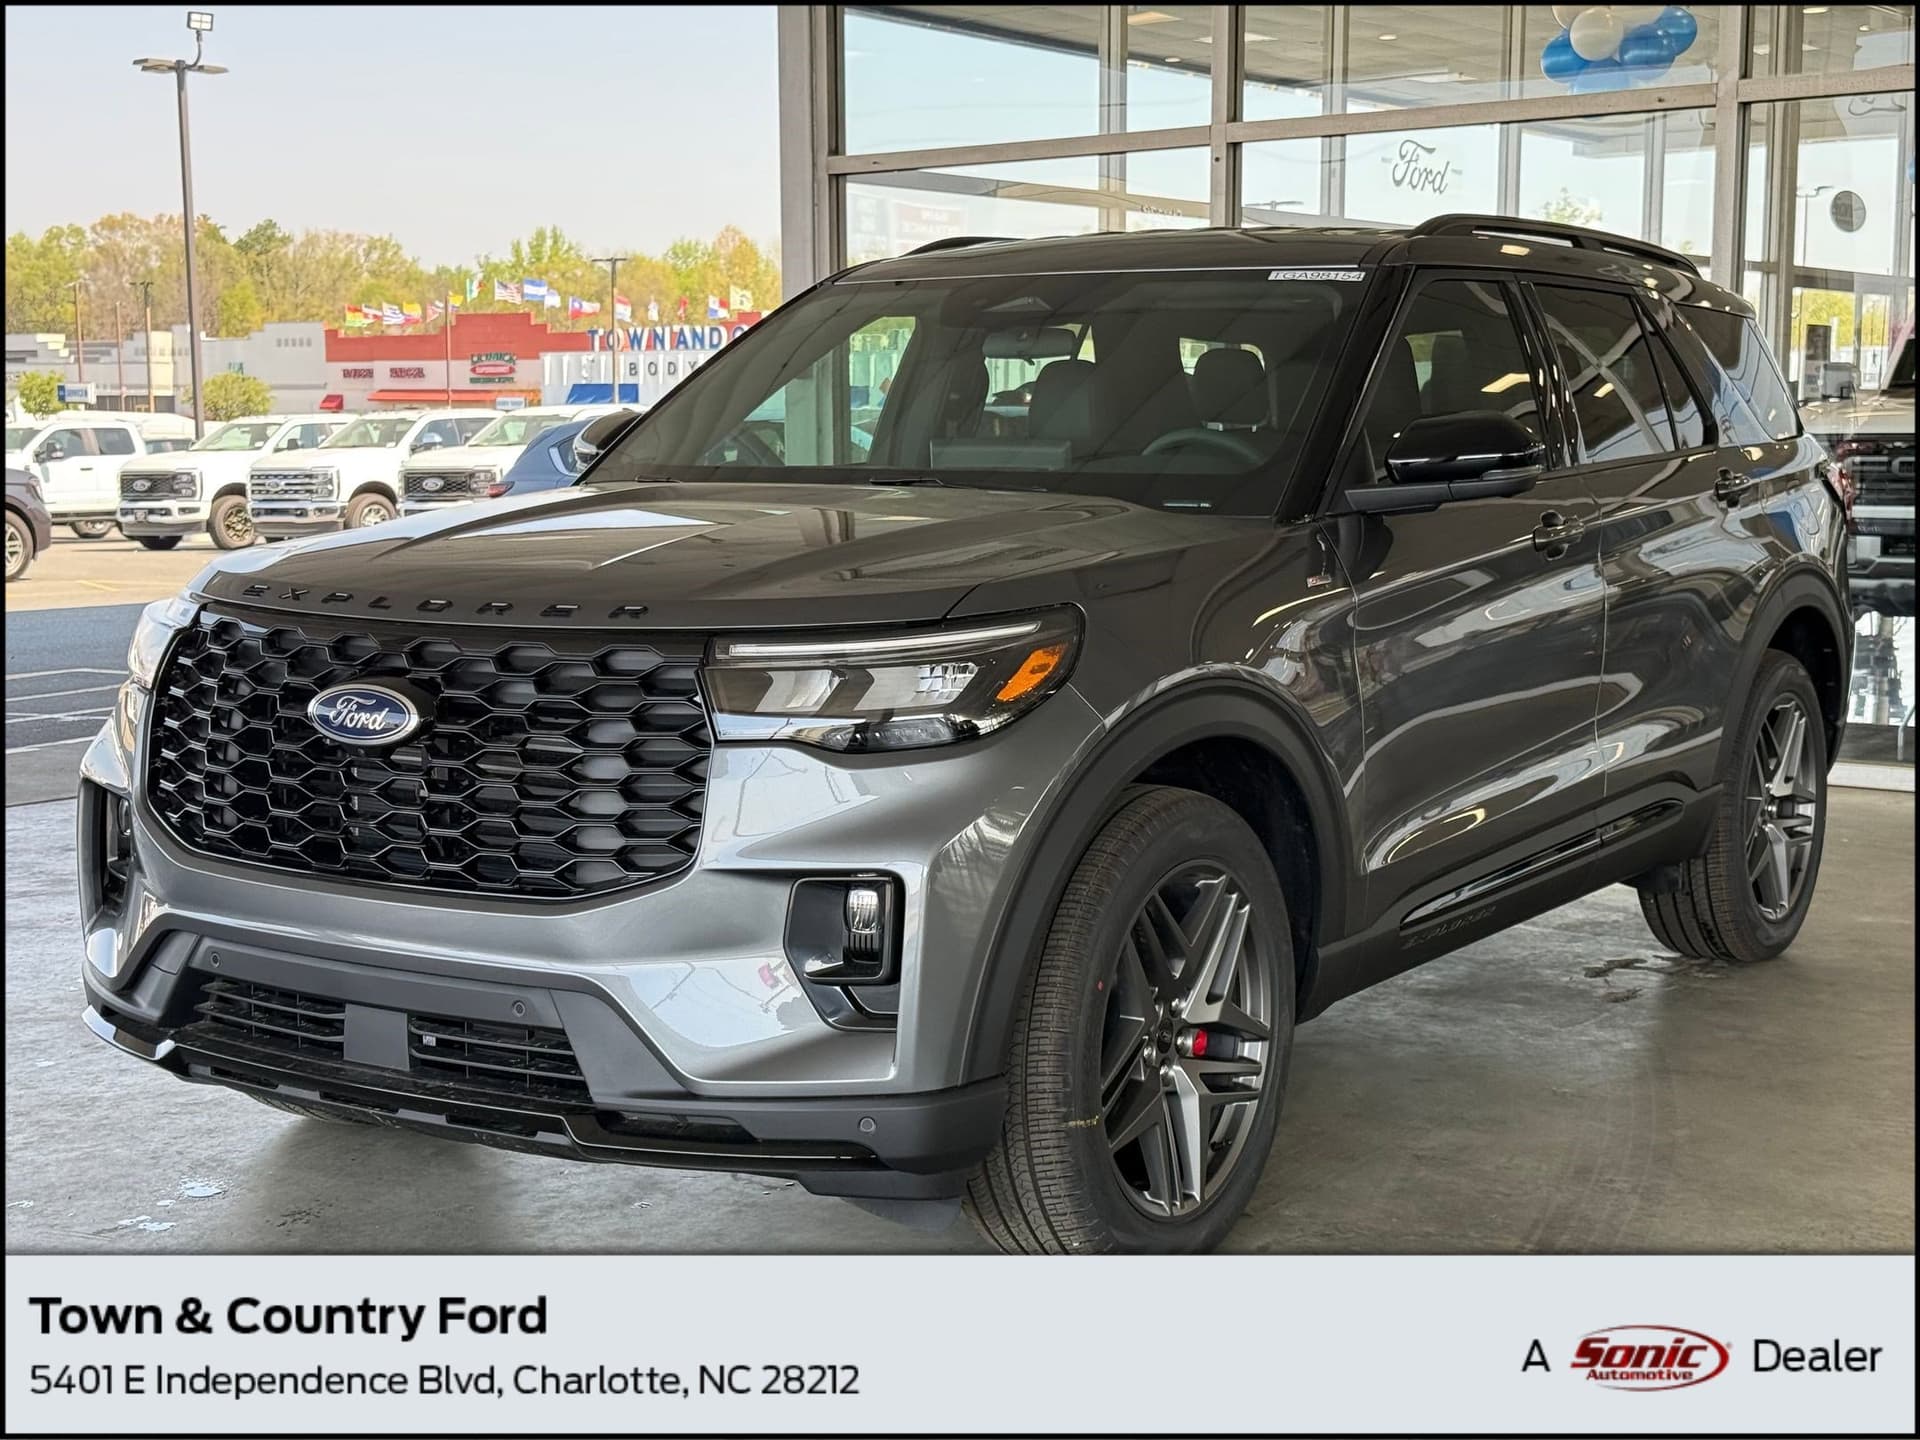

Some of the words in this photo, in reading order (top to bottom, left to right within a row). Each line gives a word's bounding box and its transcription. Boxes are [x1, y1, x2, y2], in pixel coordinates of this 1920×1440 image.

[1392, 139, 1450, 194] Ford
[588, 327, 669, 350] TOWN
[675, 326, 723, 350] AND
[629, 361, 697, 376] BODY
[241, 584, 650, 619] EXPLORER
[329, 695, 390, 731] Ford
